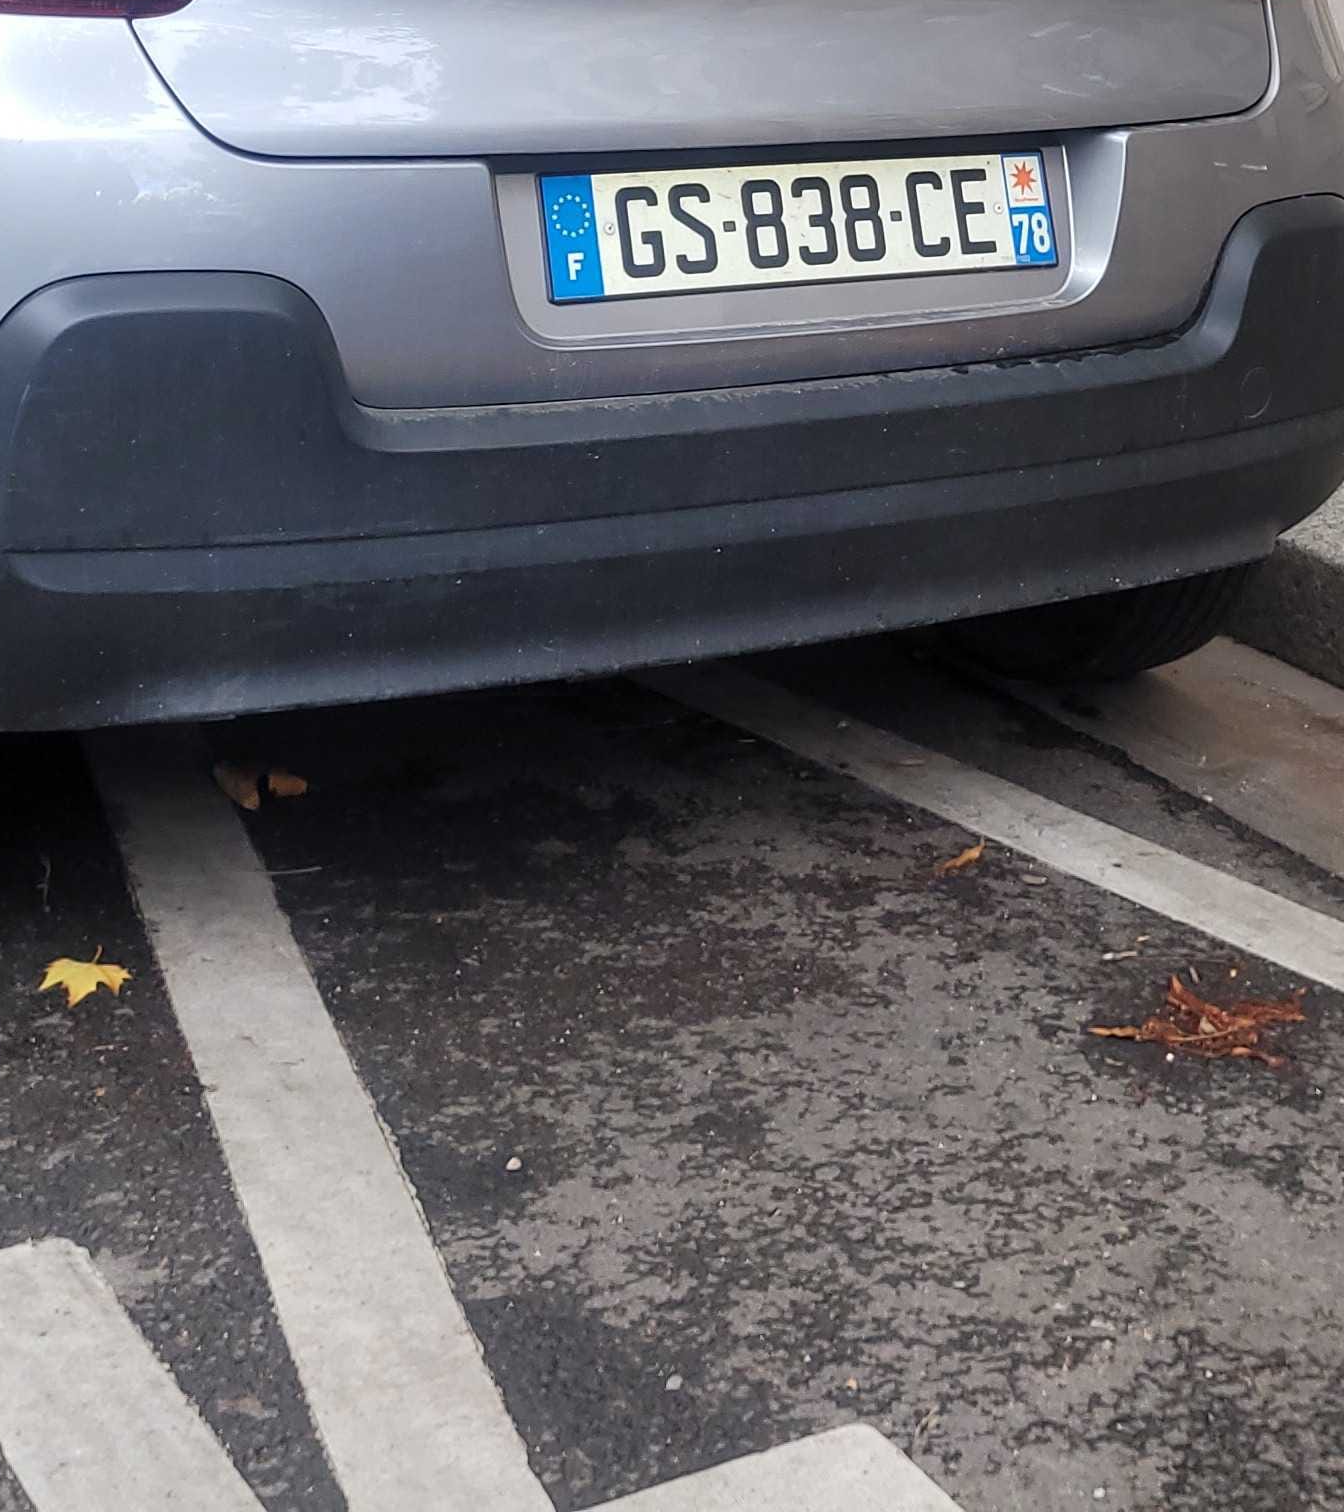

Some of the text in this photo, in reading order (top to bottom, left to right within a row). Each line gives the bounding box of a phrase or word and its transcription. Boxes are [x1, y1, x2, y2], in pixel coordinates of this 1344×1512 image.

[615, 168, 998, 279] GS-838-CE
[1012, 211, 1052, 255] 78
[567, 252, 584, 281] F
